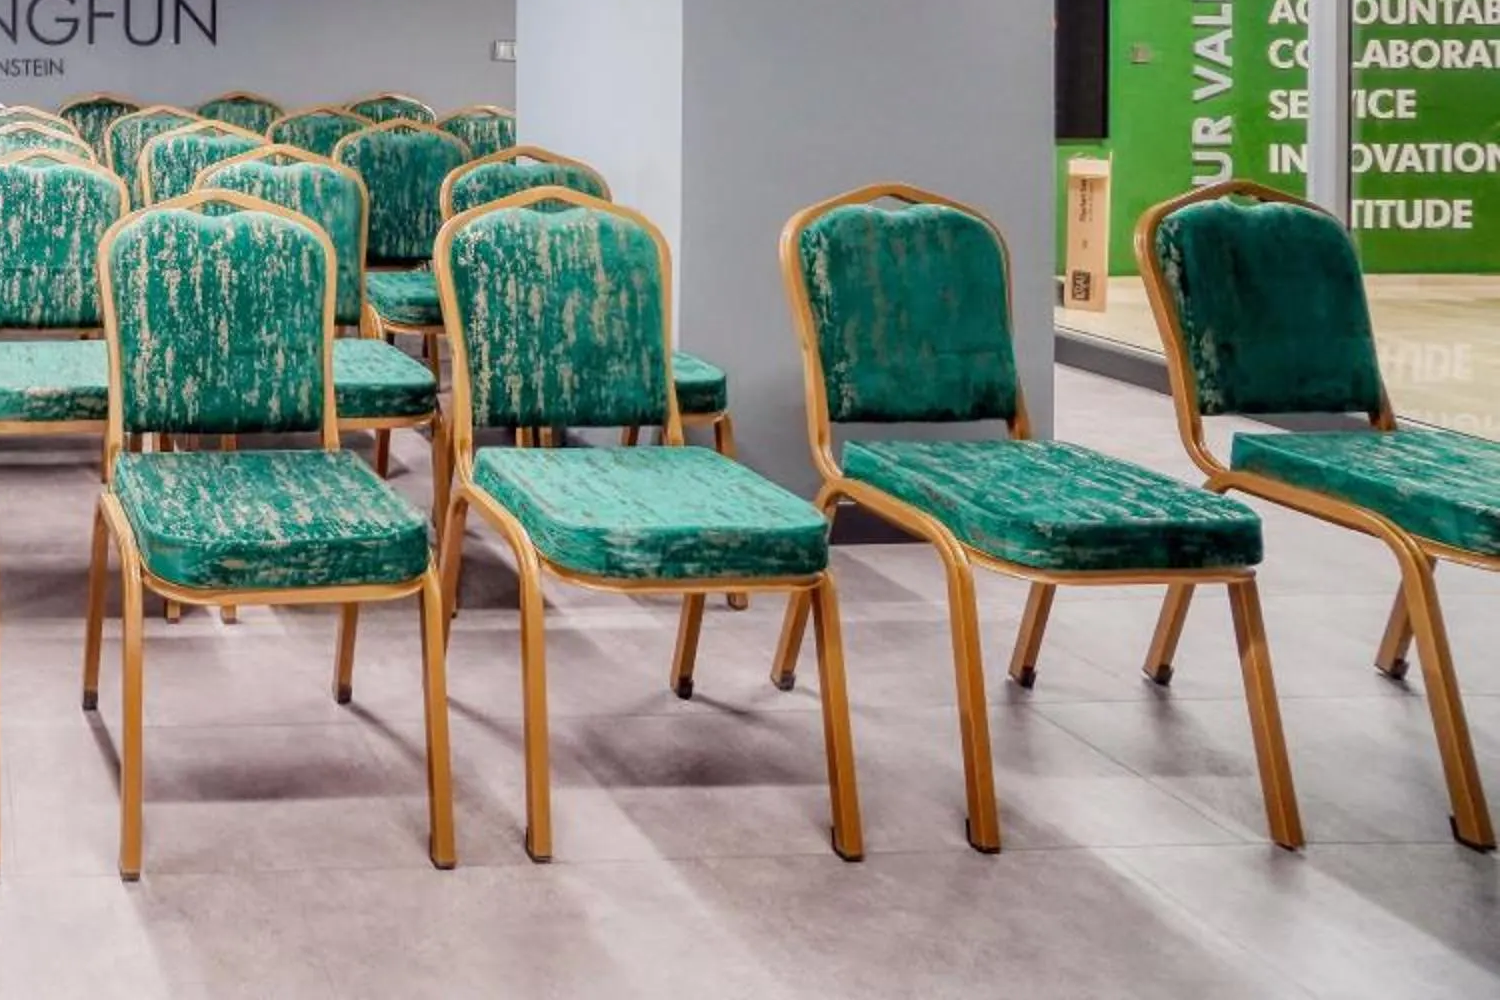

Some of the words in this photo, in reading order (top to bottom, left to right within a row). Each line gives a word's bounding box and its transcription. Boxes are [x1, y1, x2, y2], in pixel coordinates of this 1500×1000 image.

[1267, 89, 1418, 120] SEICE
[1191, 115, 1233, 187] UR
[1267, 142, 1500, 173] INOVATIO
[1351, 199, 1474, 229] TITUDE
